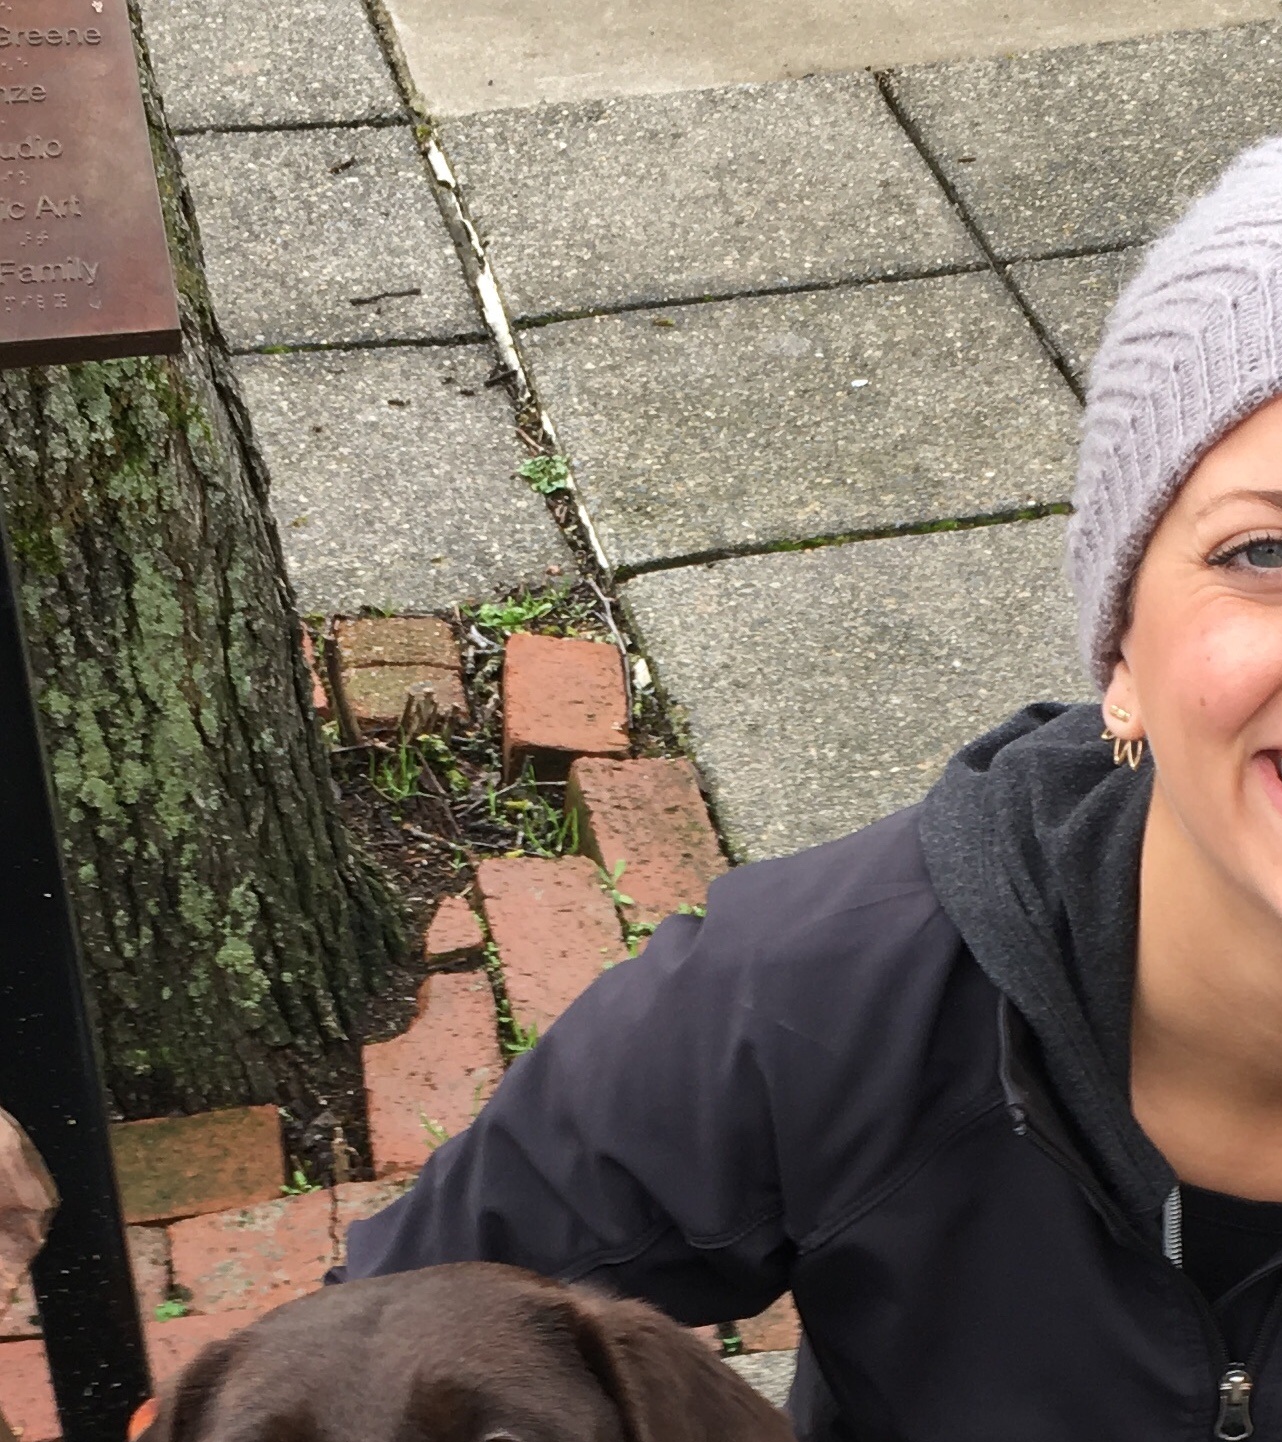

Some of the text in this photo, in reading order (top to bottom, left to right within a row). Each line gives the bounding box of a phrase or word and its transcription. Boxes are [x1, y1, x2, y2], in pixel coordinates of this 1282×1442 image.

[0, 25, 101, 47] Greene
[36, 195, 82, 219] Art
[0, 256, 100, 288] Family
